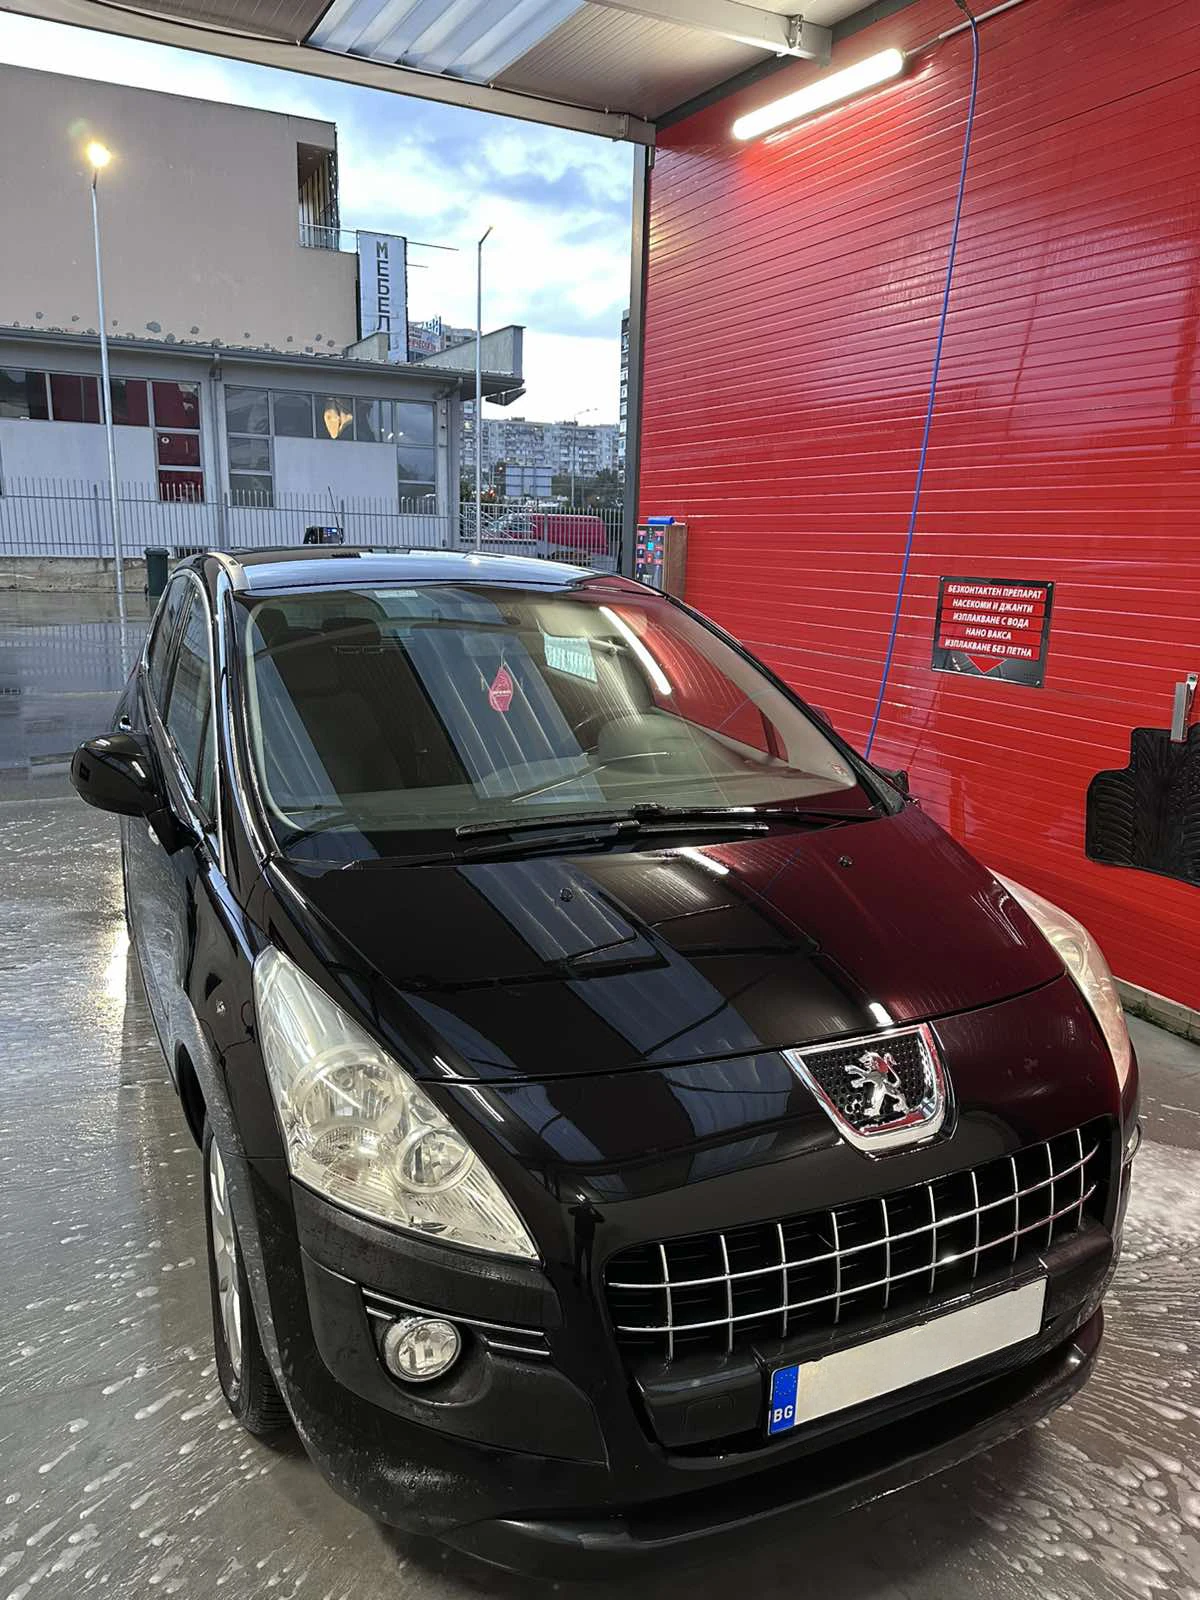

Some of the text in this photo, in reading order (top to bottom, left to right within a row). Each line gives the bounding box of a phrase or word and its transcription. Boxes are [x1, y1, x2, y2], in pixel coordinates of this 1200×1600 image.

[376, 241, 391, 351] МЕБЕЛ
[948, 584, 1043, 599] БЕЗКОНТАКТЕН ПРЕПАРАТ
[952, 599, 1033, 613] НАСЕКОМИ И ДЖАНТИ
[953, 612, 1029, 628] ИЗПЛАКВАНЕ С ВОДА
[965, 627, 1012, 640] НАНО ВАКСА
[944, 638, 1032, 657] ИЗПЛАКВАНЕ БЕЗ ПЕТНА
[773, 1405, 793, 1423] BG
